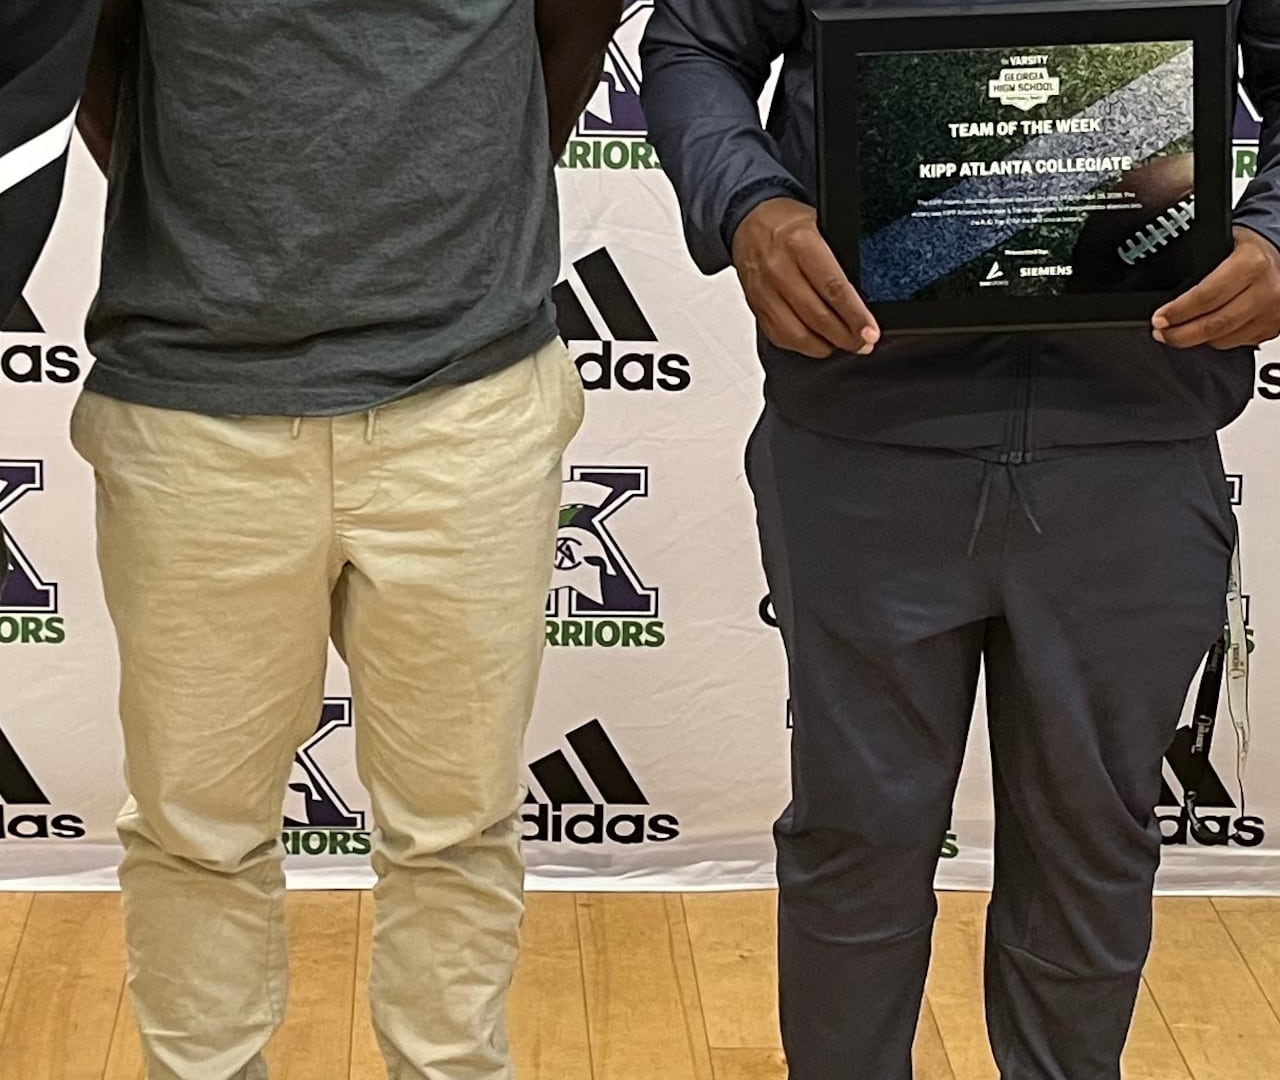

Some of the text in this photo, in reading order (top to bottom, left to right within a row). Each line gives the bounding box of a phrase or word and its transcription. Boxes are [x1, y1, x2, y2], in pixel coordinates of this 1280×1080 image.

[1009, 55, 1049, 66] VARSITY
[1004, 72, 1045, 82] GEORGIA
[993, 80, 1054, 93] HIGH SCHOOL
[948, 117, 1101, 138] TEAM OF THE WEEK
[920, 155, 1133, 179] KIPP ATLANTA COLLEGIATE
[1020, 265, 1073, 278] SIEMENS
[575, 340, 692, 392] das
[520, 803, 681, 845] didas
